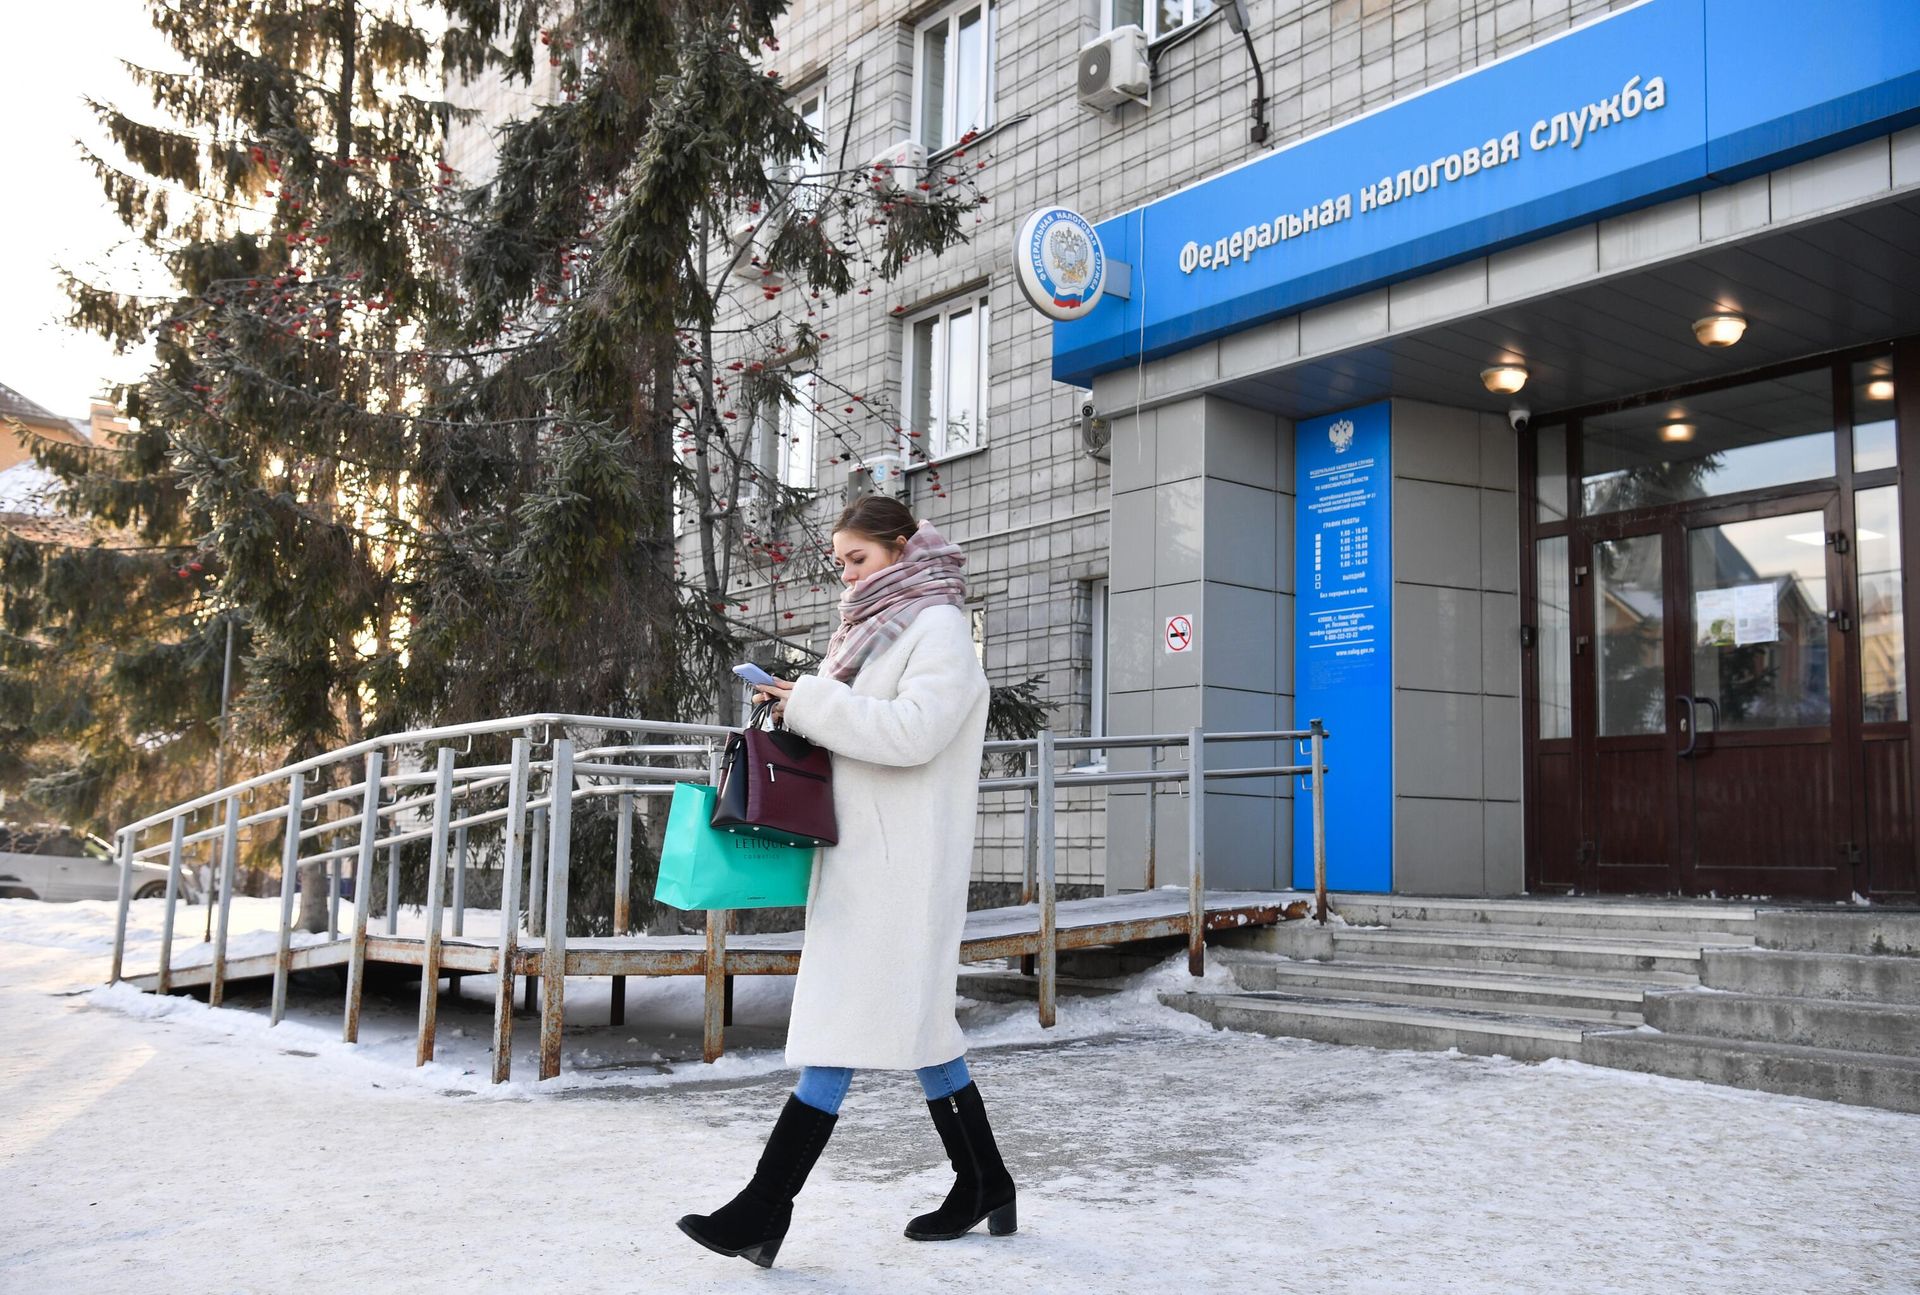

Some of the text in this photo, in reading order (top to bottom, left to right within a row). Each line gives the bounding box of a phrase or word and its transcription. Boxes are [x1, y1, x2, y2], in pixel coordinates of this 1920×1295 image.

[1179, 74, 1666, 275] Федеральная налоговая служба
[1032, 212, 1101, 290] ФЕДЕРАЛЬНАЯ НАЛОГОВАЯ СЛУЖБА
[1323, 517, 1360, 529] ГРАФИК РАБОТЫ
